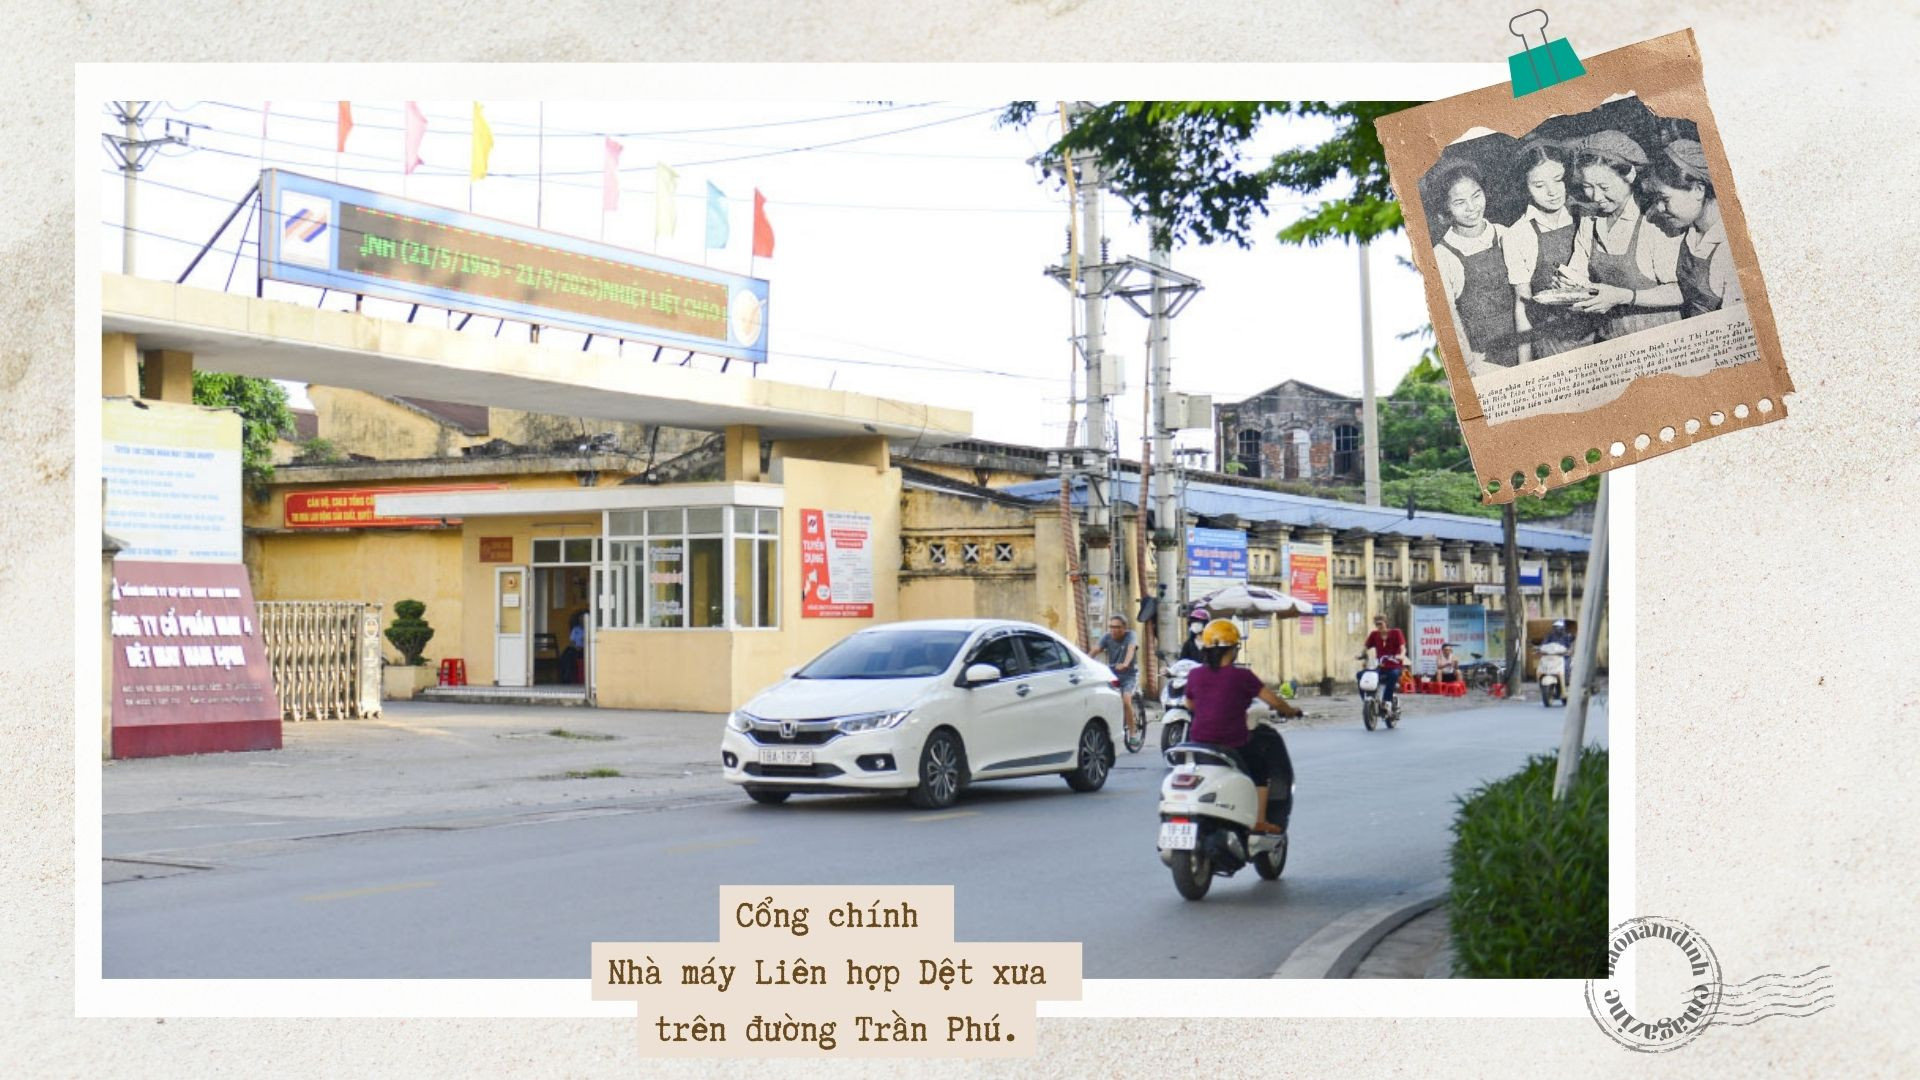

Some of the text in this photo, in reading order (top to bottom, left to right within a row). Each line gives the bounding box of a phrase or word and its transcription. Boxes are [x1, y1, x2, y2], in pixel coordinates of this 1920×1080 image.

[1629, 349, 1646, 357] Nam
[1591, 381, 1608, 391] danh
[141, 616, 158, 636] TY
[159, 607, 179, 637] CỔ
[179, 609, 215, 636] PHẦN
[126, 641, 152, 667] DỆT
